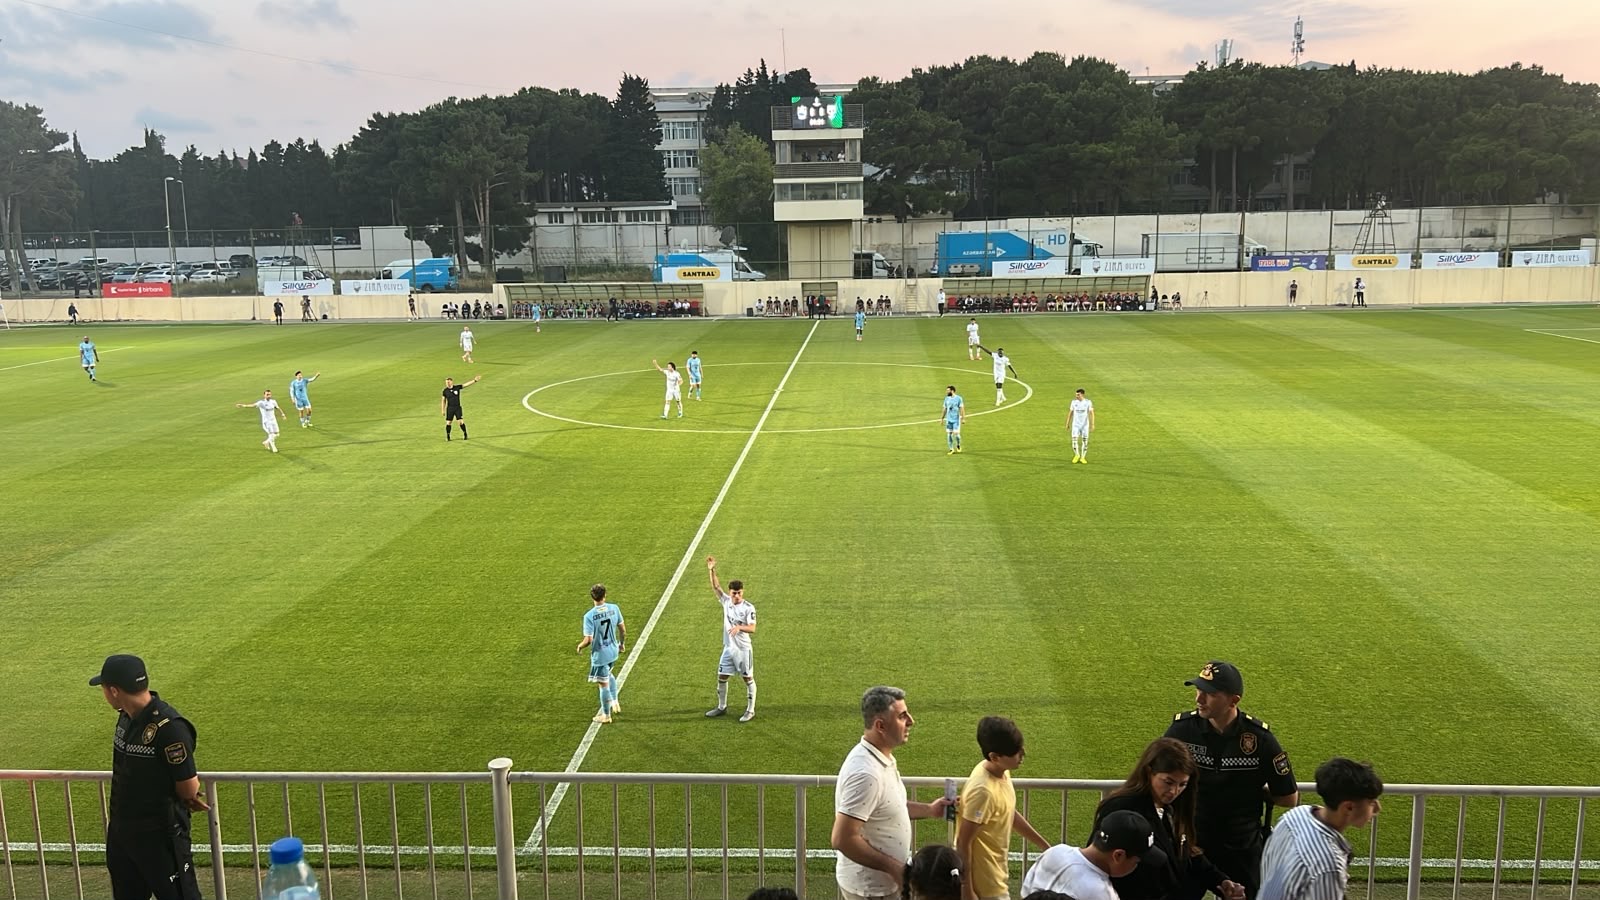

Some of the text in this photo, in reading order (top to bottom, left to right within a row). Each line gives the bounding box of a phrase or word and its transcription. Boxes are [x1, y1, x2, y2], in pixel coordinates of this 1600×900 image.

[1048, 235, 1066, 245] HD
[1536, 254, 1579, 263] ZIRA OLIVES
[1104, 261, 1146, 271] ZIRA OLIVES
[364, 283, 404, 292] ZIRA OLIVES
[601, 618, 610, 640] 7
